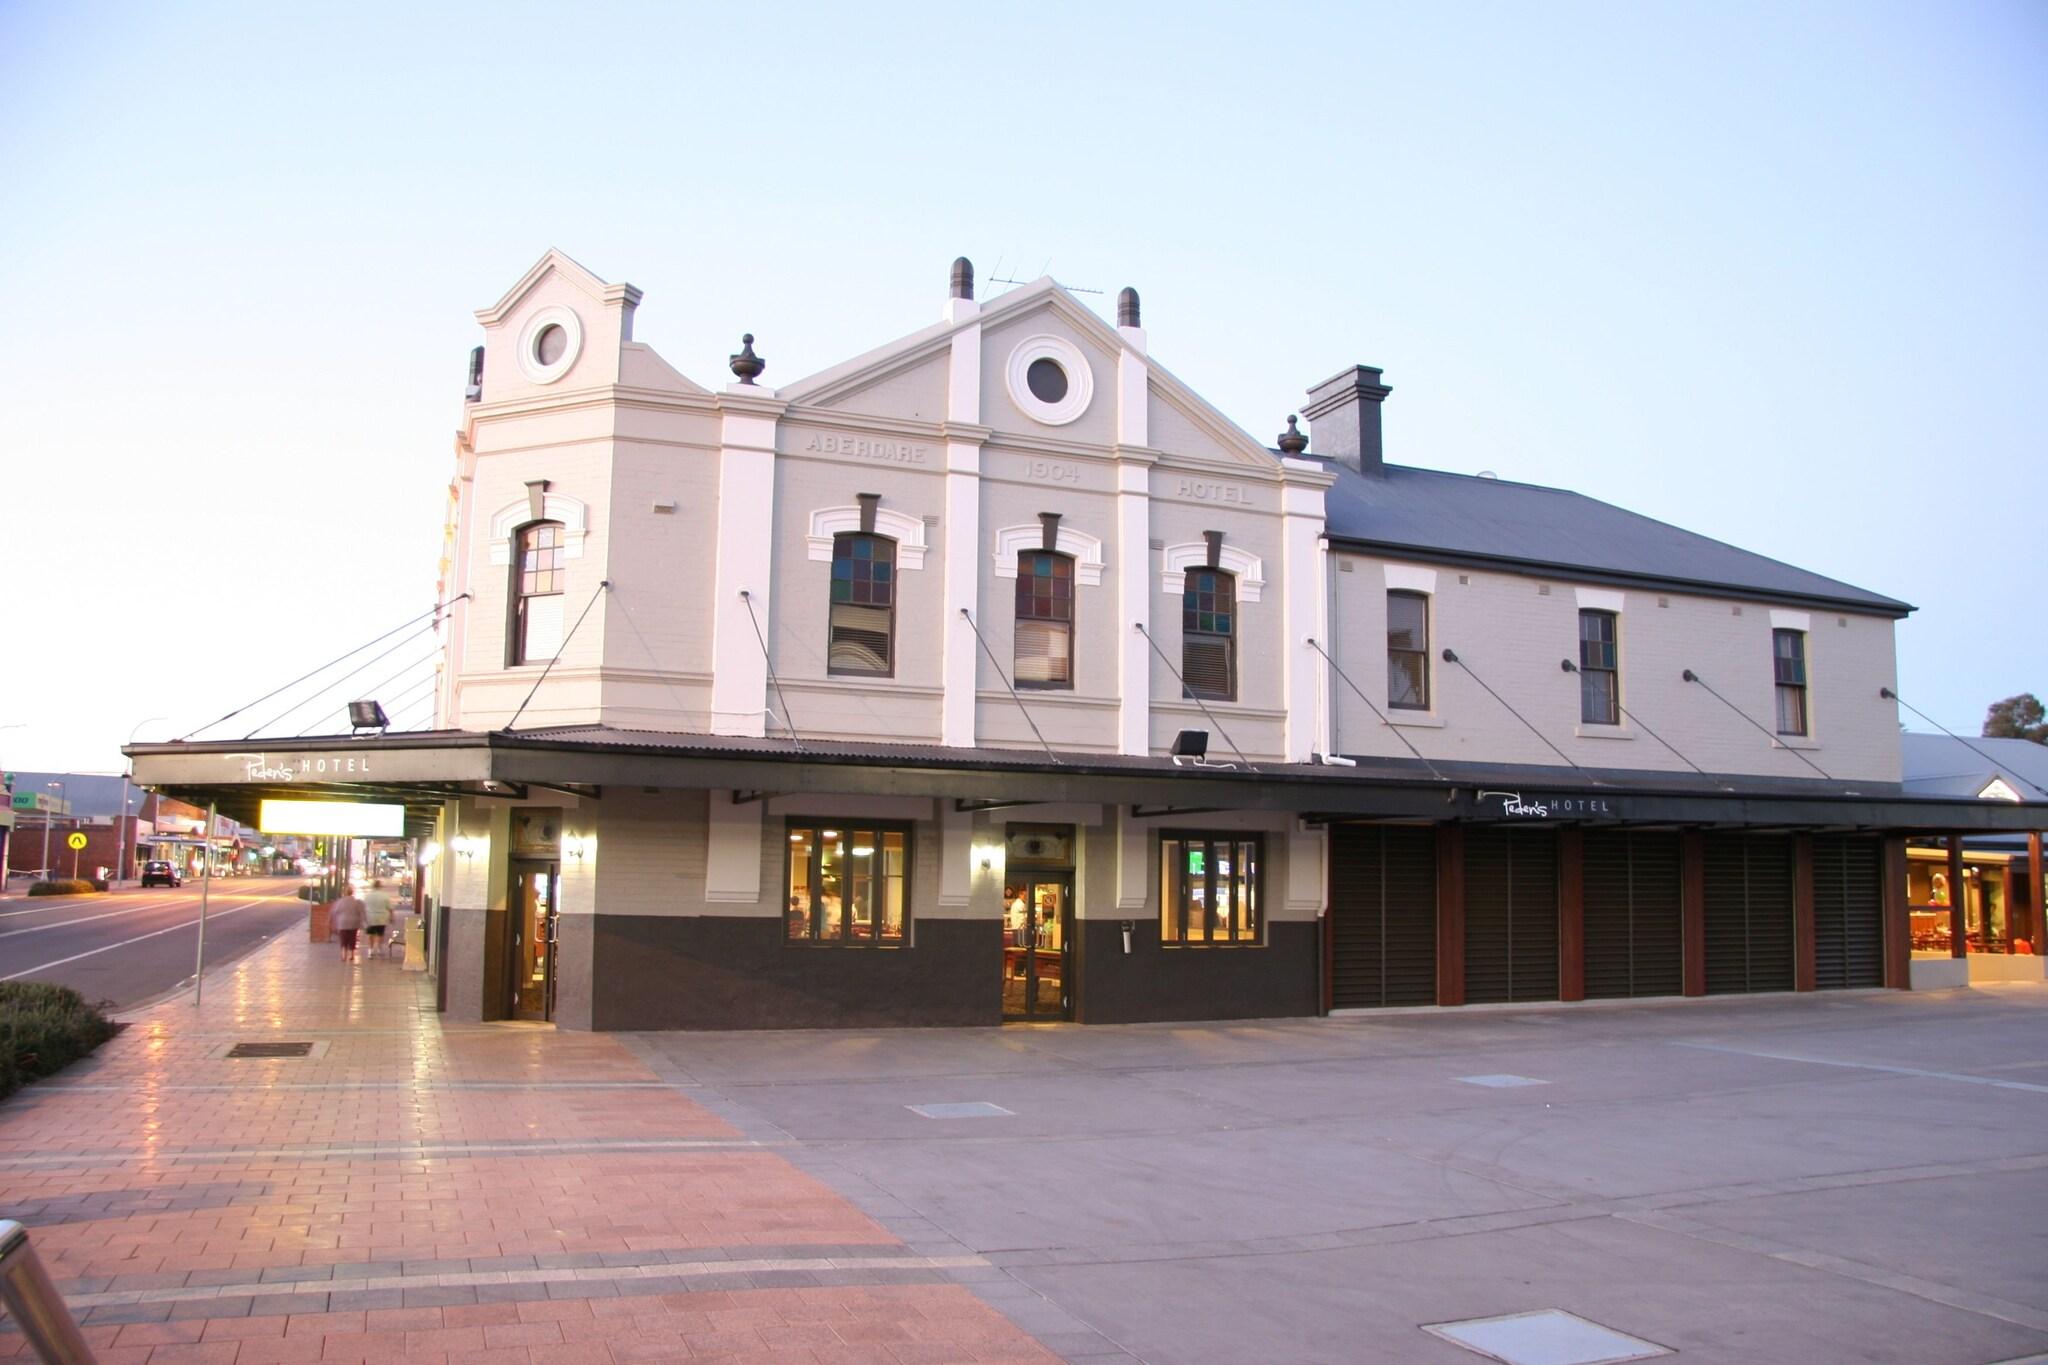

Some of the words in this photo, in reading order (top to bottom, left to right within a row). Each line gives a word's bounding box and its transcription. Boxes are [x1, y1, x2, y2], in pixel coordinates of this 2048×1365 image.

[805, 433, 927, 464] ABERDARE
[1026, 461, 1081, 483] 1904
[1177, 479, 1254, 505] HOTEL
[224, 752, 293, 781] Peden's
[302, 759, 370, 772] HOTEL
[1482, 792, 1548, 817] Peden's
[1551, 800, 1609, 812] HOTEL
